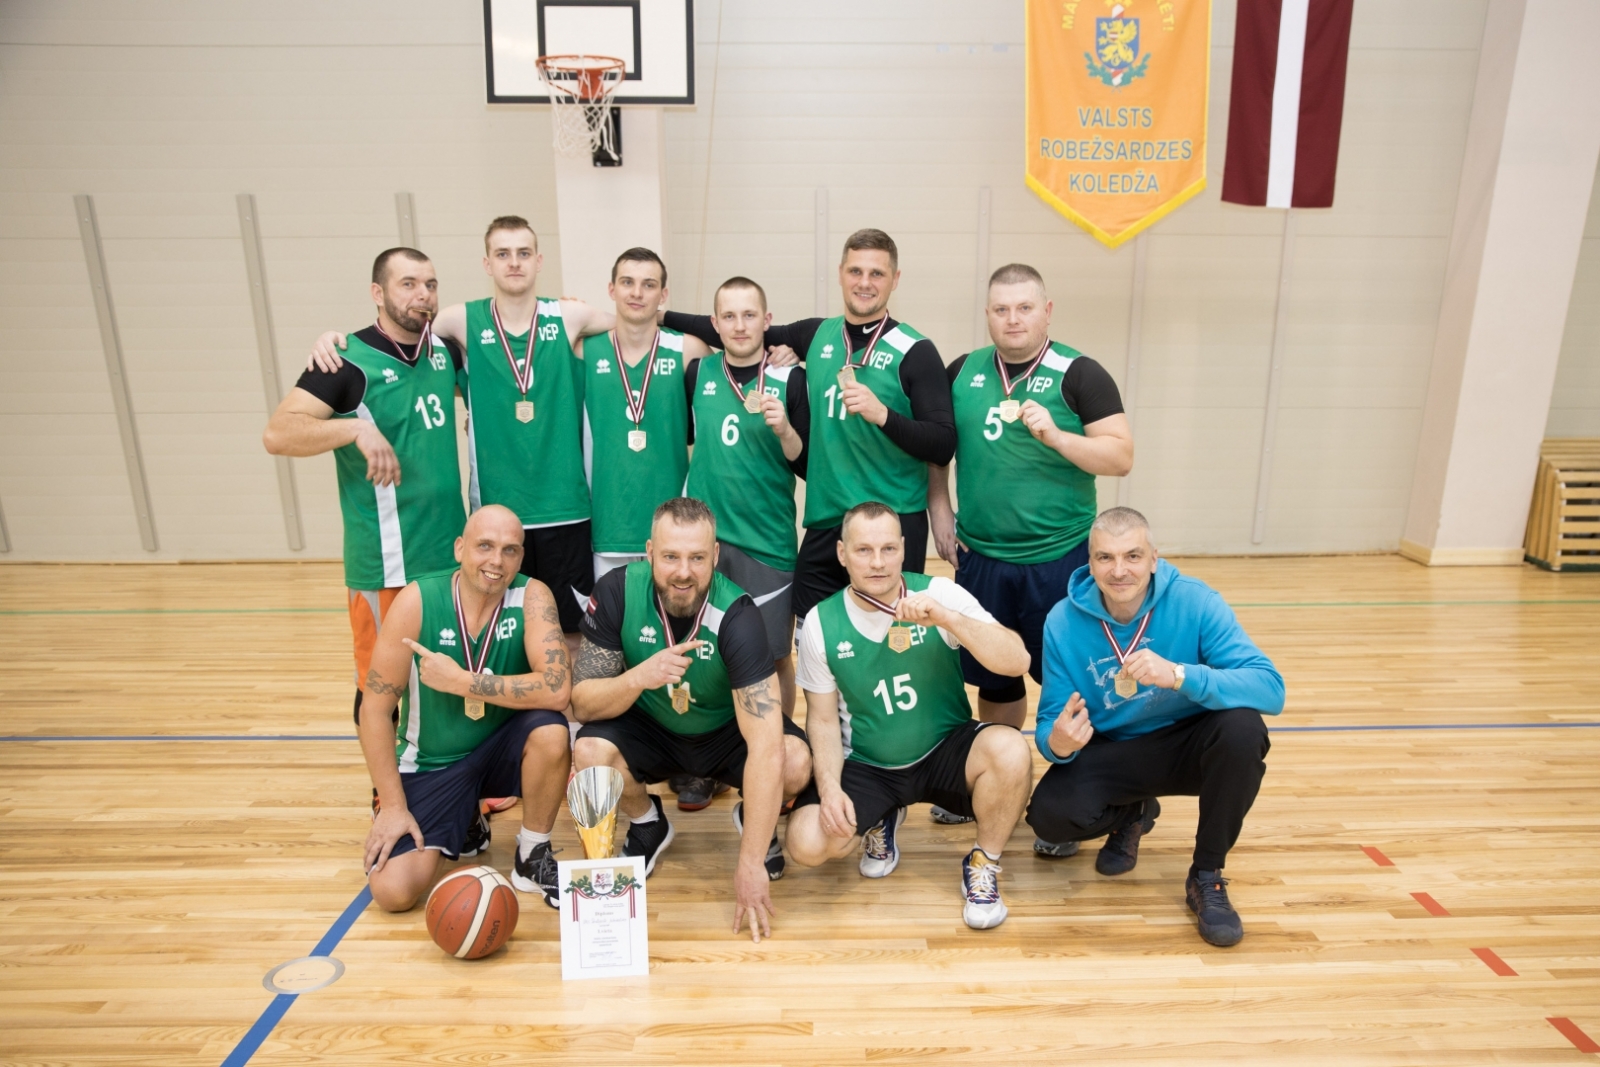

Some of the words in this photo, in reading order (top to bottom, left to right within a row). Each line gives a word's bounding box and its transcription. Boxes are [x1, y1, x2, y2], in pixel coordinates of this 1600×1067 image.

[1079, 108, 1152, 127] VALSTS
[1041, 137, 1192, 160] ROBEŽSARDZES
[1070, 171, 1159, 193] KOLEDŽA
[538, 323, 559, 342] VEP
[428, 352, 447, 371] VEP
[652, 358, 676, 376] VEP
[869, 349, 894, 371] VEP
[1026, 375, 1054, 393] VEP
[414, 393, 446, 430] 13
[721, 413, 740, 446] 6
[983, 406, 1003, 442] 5
[495, 616, 518, 642] VEP
[873, 672, 918, 716] 15
